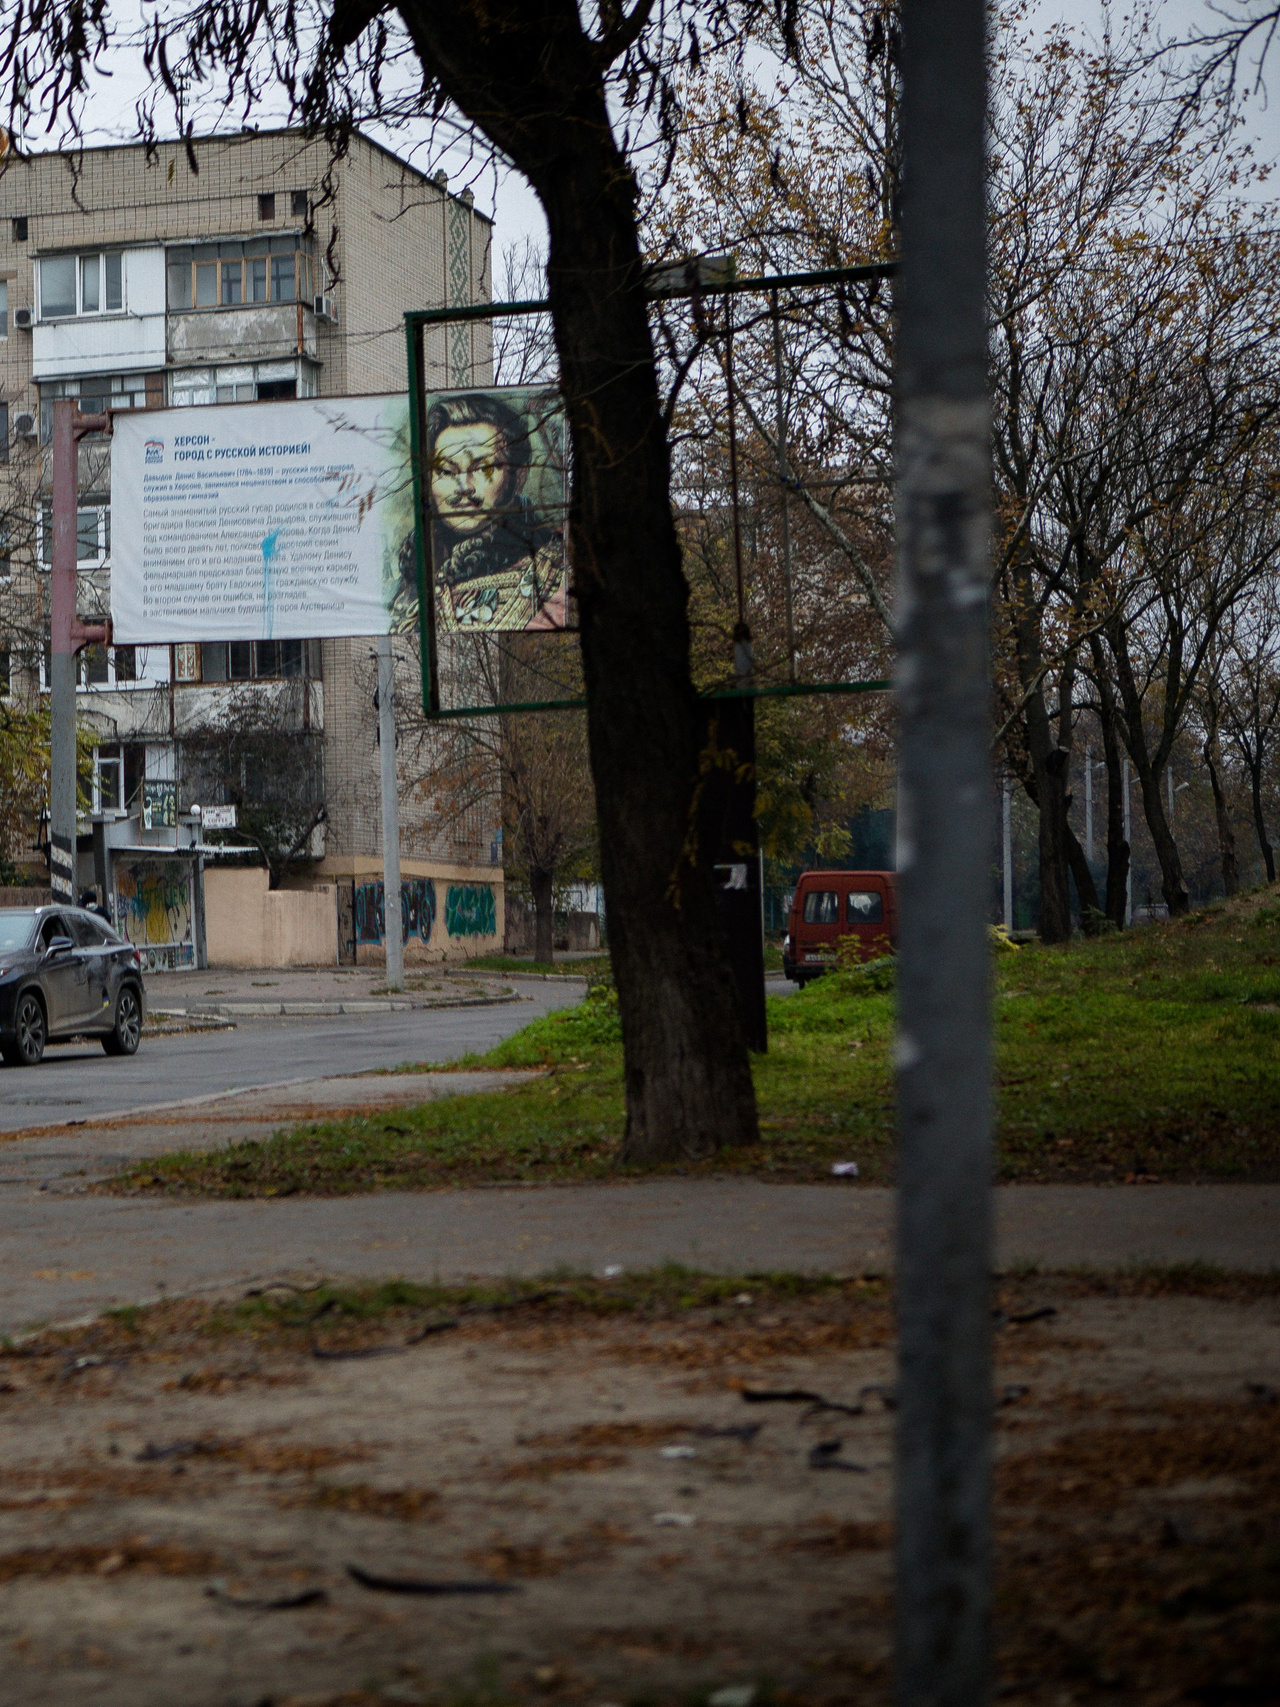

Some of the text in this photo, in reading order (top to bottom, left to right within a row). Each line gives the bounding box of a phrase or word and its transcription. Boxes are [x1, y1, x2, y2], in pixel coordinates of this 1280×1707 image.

[174, 435, 210, 447] ХЕРСОН
[174, 449, 205, 462] ГОРОД
[206, 448, 213, 460] С
[214, 444, 256, 459] РУССКОЙ
[143, 474, 173, 483] Давыдов
[175, 471, 196, 481] Денис
[197, 470, 236, 479] Васильевич
[281, 464, 309, 476] русский
[143, 484, 168, 493] служил
[143, 494, 187, 503] образованию
[143, 508, 169, 519] Самый
[170, 505, 217, 517] знаменитый
[219, 504, 250, 516] русский
[251, 504, 273, 514] гусар
[275, 502, 308, 513] родился
[143, 520, 184, 532] бригадира
[185, 519, 217, 529] Василия
[218, 516, 265, 527] Денисовича
[308, 511, 358, 523] служившего
[143, 534, 157, 544] под
[158, 531, 219, 542] командованием
[220, 529, 266, 541] Александра
[308, 524, 331, 535] Когда
[332, 523, 361, 535] Денису
[143, 545, 163, 556] было
[164, 544, 186, 555] всего
[187, 543, 214, 554] девять
[314, 537, 339, 548] своим
[143, 557, 186, 568] вниманием
[187, 556, 200, 567] его
[208, 555, 222, 566] его
[223, 553, 262, 566] младшего
[290, 550, 323, 562] Удалому
[323, 549, 353, 560] Денису
[143, 562, 360, 581] фельдмаршал предсказал блестящую военную карьеру,
[149, 583, 163, 593] его
[164, 581, 205, 592] младшему
[205, 580, 228, 591] брату
[229, 578, 267, 590] Евдокиму
[276, 576, 329, 588] гражданскую
[143, 594, 153, 606] Во
[154, 595, 182, 606] втором
[183, 593, 210, 605] случае
[211, 593, 222, 603] он
[222, 590, 255, 603] ошибся,
[149, 607, 199, 618] застенчивом
[199, 605, 236, 616] мальчике
[276, 602, 299, 613] героя
[300, 600, 345, 613] Аустерлица
